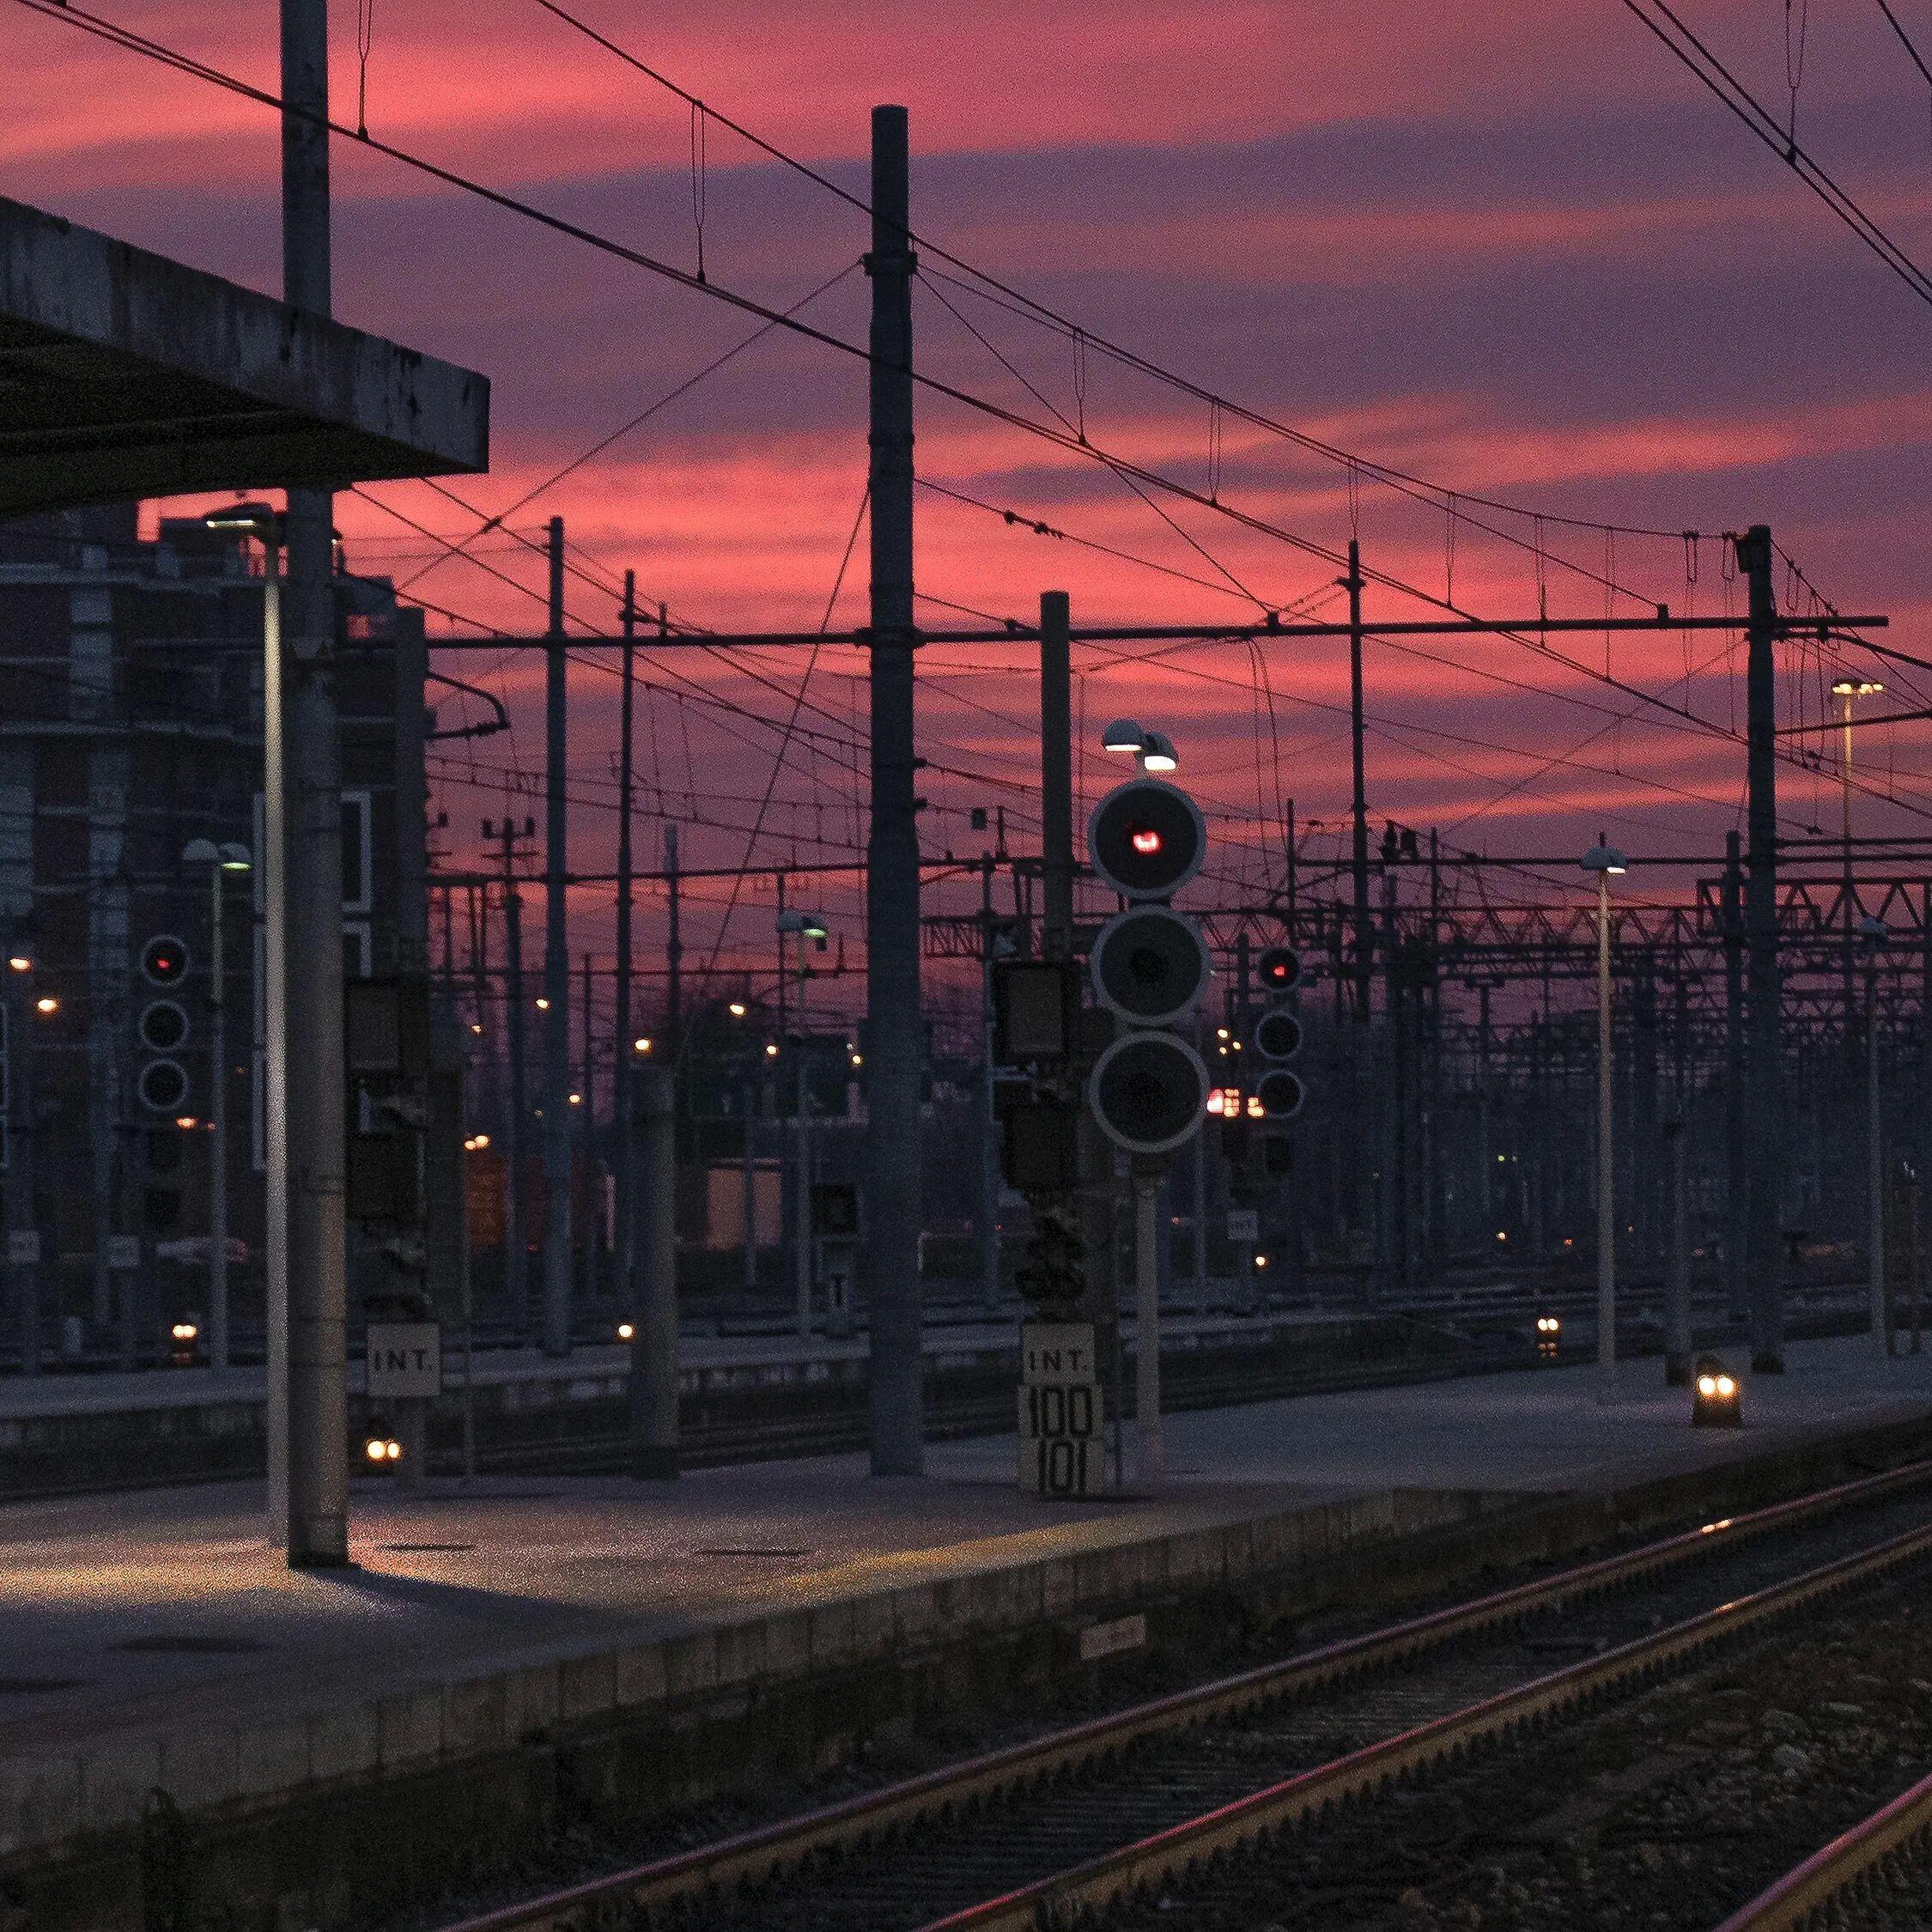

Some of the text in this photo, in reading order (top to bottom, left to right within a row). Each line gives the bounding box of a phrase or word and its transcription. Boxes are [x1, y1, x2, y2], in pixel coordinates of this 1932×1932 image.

[1029, 1349, 1088, 1372] INT.
[1029, 1385, 1092, 1438] 100
[1038, 1440, 1087, 1492] 101
